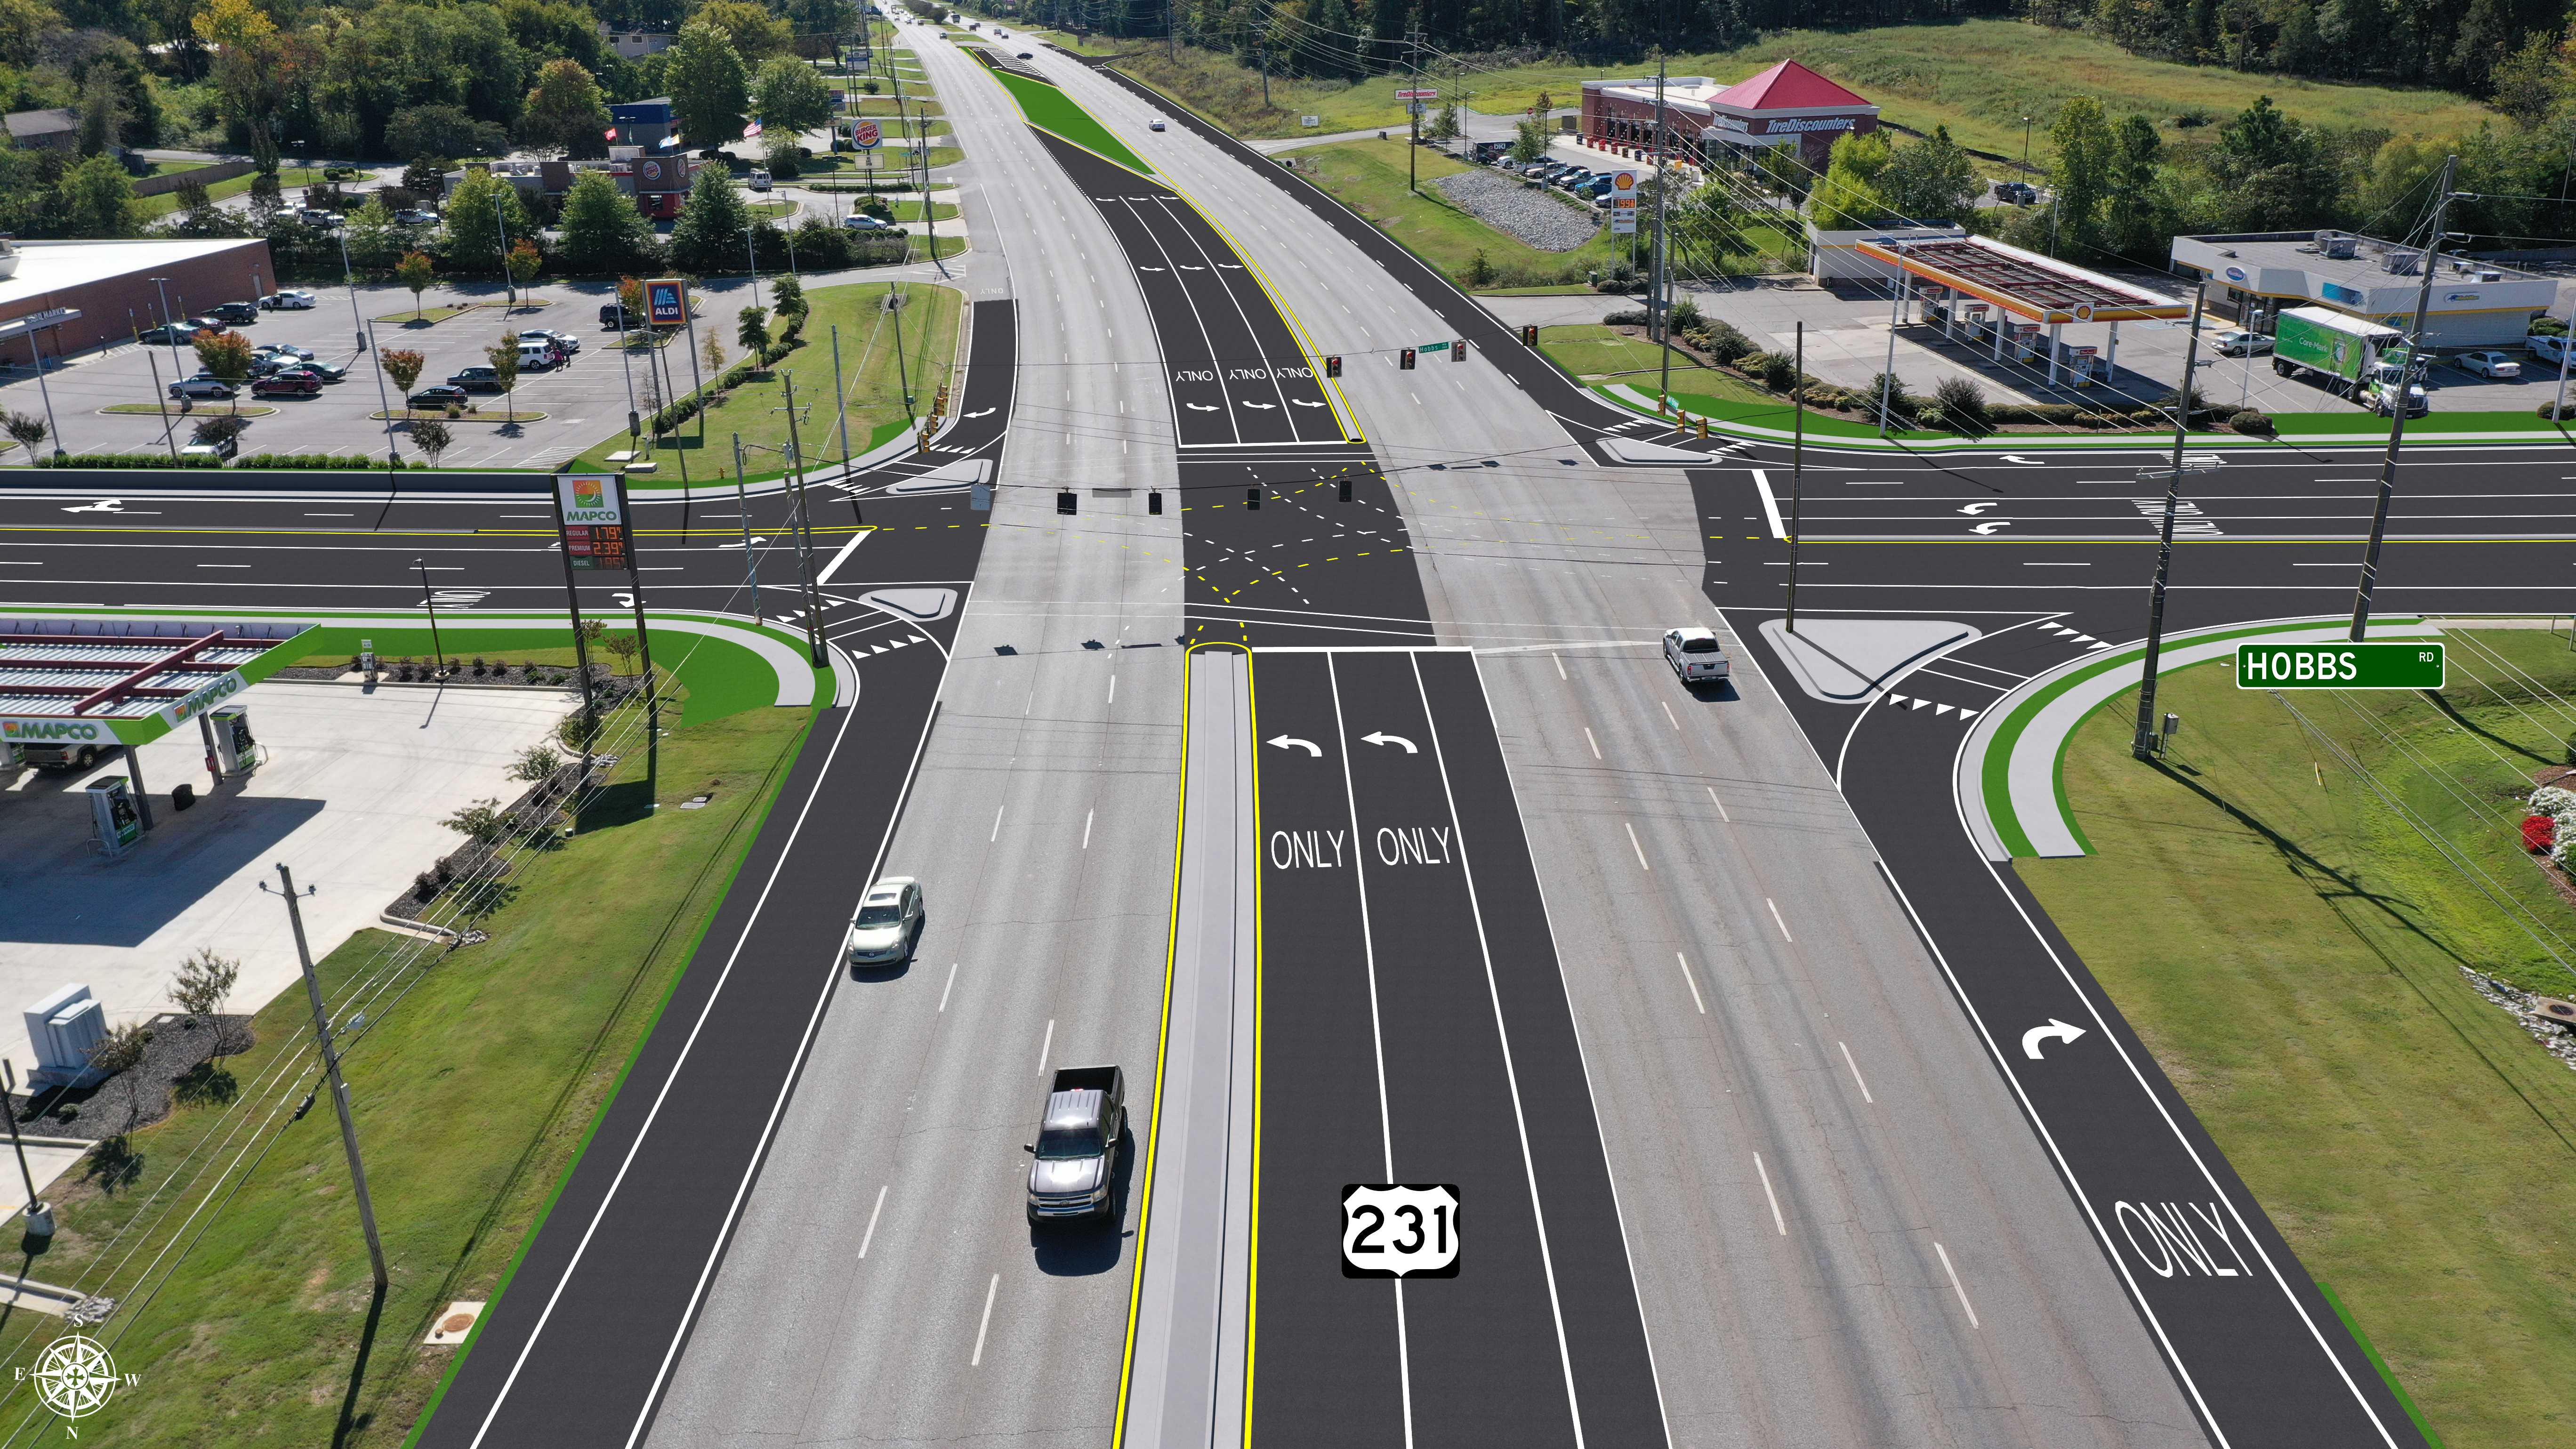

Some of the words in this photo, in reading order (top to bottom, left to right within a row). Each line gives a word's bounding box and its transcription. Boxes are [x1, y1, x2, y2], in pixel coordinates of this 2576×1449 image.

[855, 124, 877, 136] BURGER
[1766, 117, 1856, 133] TireDiscounters
[856, 129, 878, 143] KING
[43, 306, 66, 319] MARKET
[2299, 337, 2328, 353] Core-Mark
[1175, 370, 1213, 382] ONLY
[1229, 369, 1266, 380] ONLY
[1277, 367, 1313, 378] ONLY
[566, 511, 617, 521] MAPCO
[187, 677, 237, 717] MAPCO
[21, 722, 98, 740] MAPCO
[1271, 830, 1344, 869] ONLY
[1377, 827, 1450, 866] ONLY
[2115, 1200, 2253, 1278] ONLY
